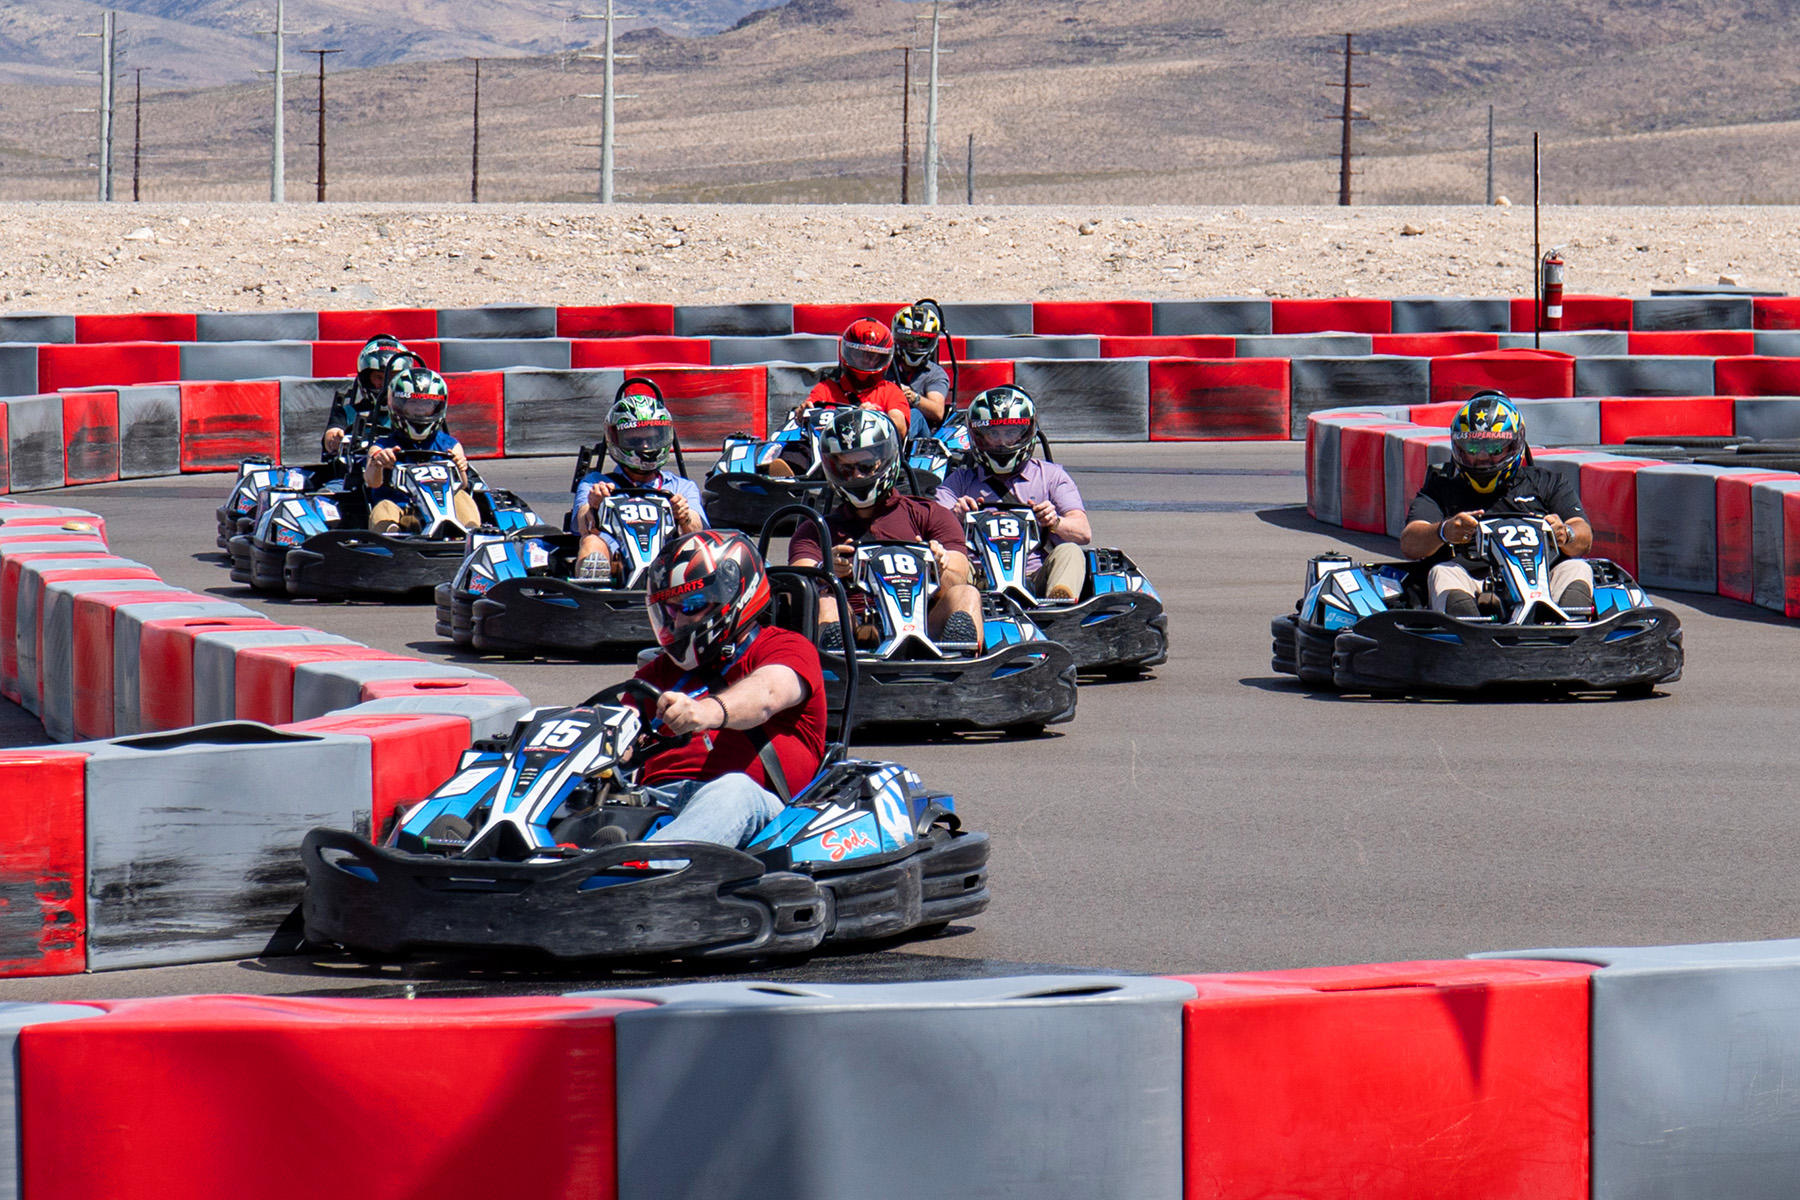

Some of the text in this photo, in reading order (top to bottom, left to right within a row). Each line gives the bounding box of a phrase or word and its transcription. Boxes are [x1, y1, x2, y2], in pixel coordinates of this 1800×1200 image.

[411, 466, 448, 481] 28
[619, 505, 658, 521] 30
[986, 519, 1019, 537] 13
[1498, 525, 1539, 547] 23
[879, 554, 917, 574] 18
[529, 720, 591, 747] 15
[821, 828, 877, 862] Sodi
